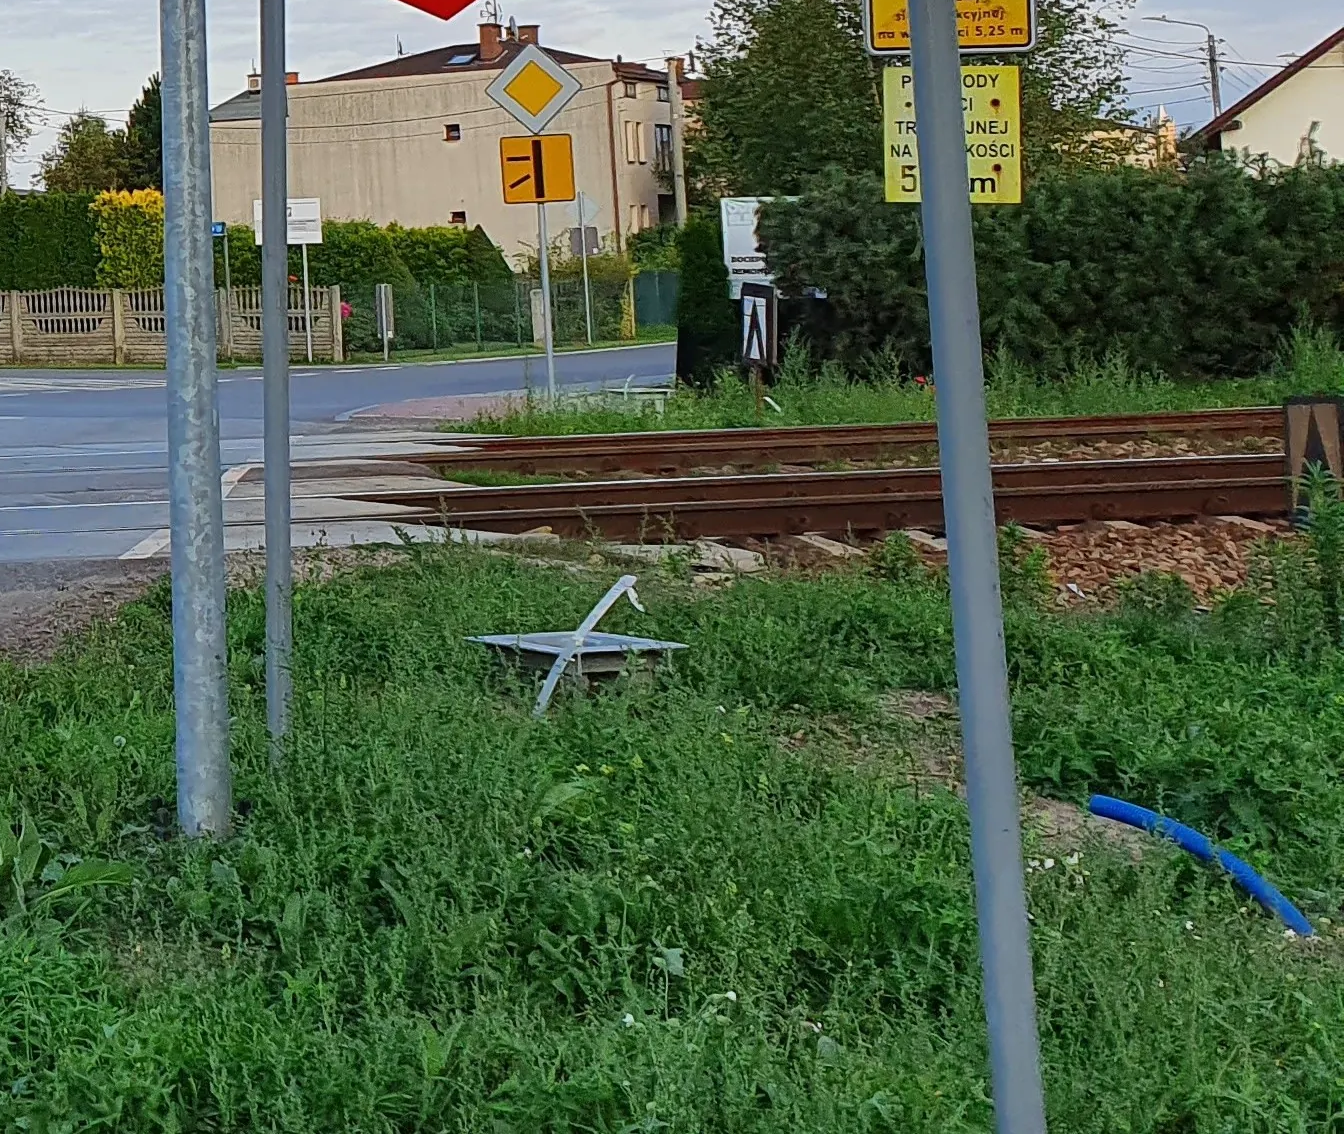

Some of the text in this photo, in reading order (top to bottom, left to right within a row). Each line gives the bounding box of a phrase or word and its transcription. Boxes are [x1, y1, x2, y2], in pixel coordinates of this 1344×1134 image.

[975, 25, 1005, 38] 5,25
[1010, 26, 1024, 36] m
[890, 143, 912, 158] NA
